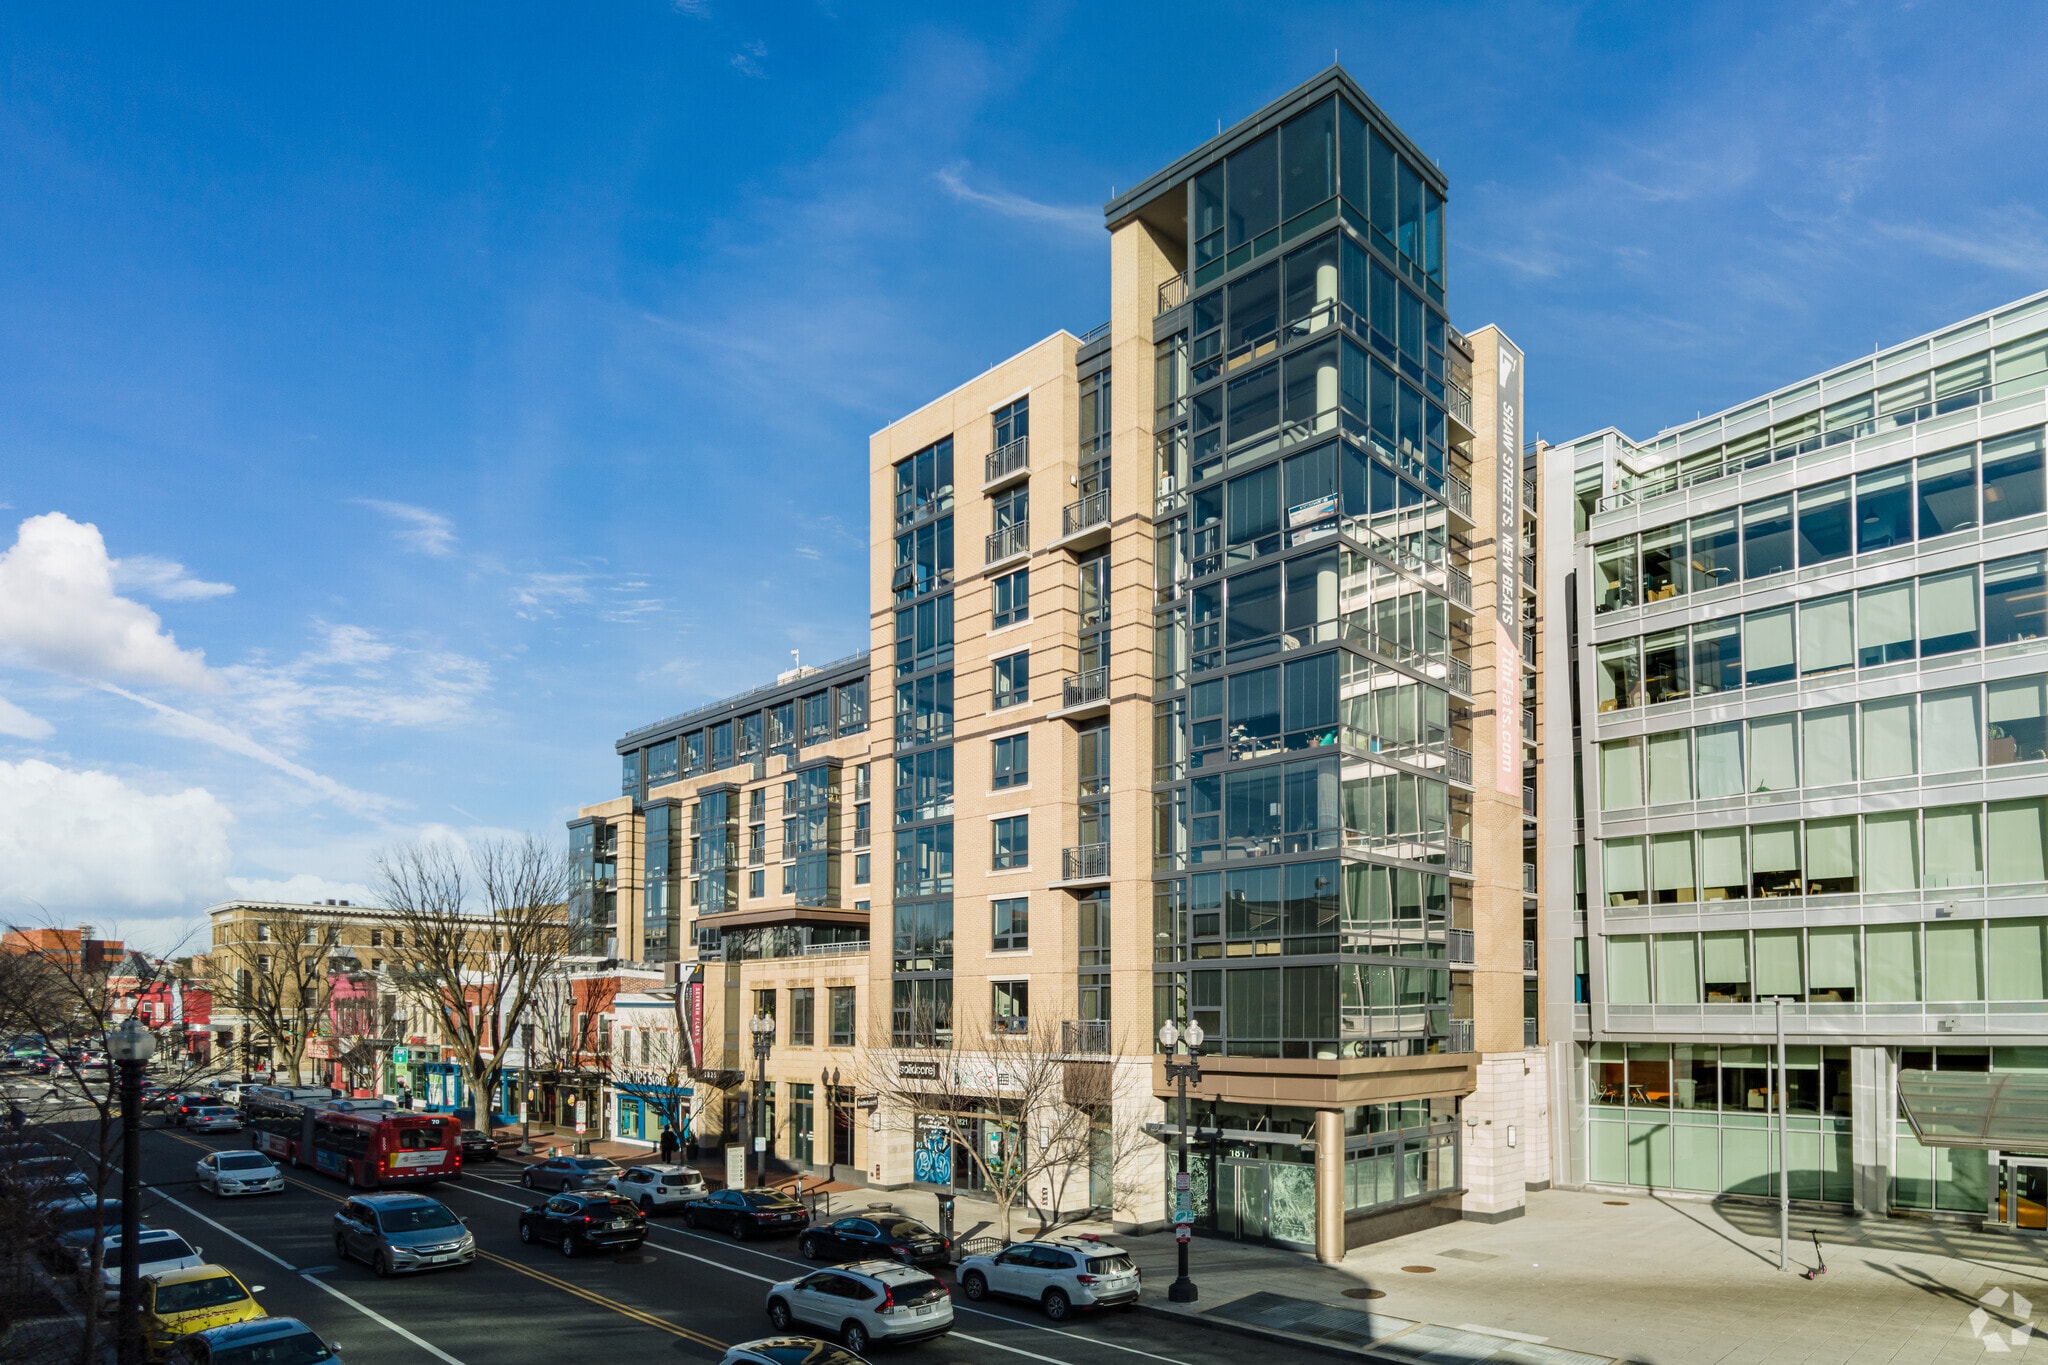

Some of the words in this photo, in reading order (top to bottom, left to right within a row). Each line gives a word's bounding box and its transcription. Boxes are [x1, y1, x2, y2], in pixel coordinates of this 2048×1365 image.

[1502, 401, 1514, 454] SHAW
[1502, 532, 1514, 573] NEW
[1502, 574, 1513, 625] BEATS
[1501, 645, 1514, 772] 7thFlats.com
[633, 1071, 647, 1085] UPS
[648, 1073, 667, 1086] Store
